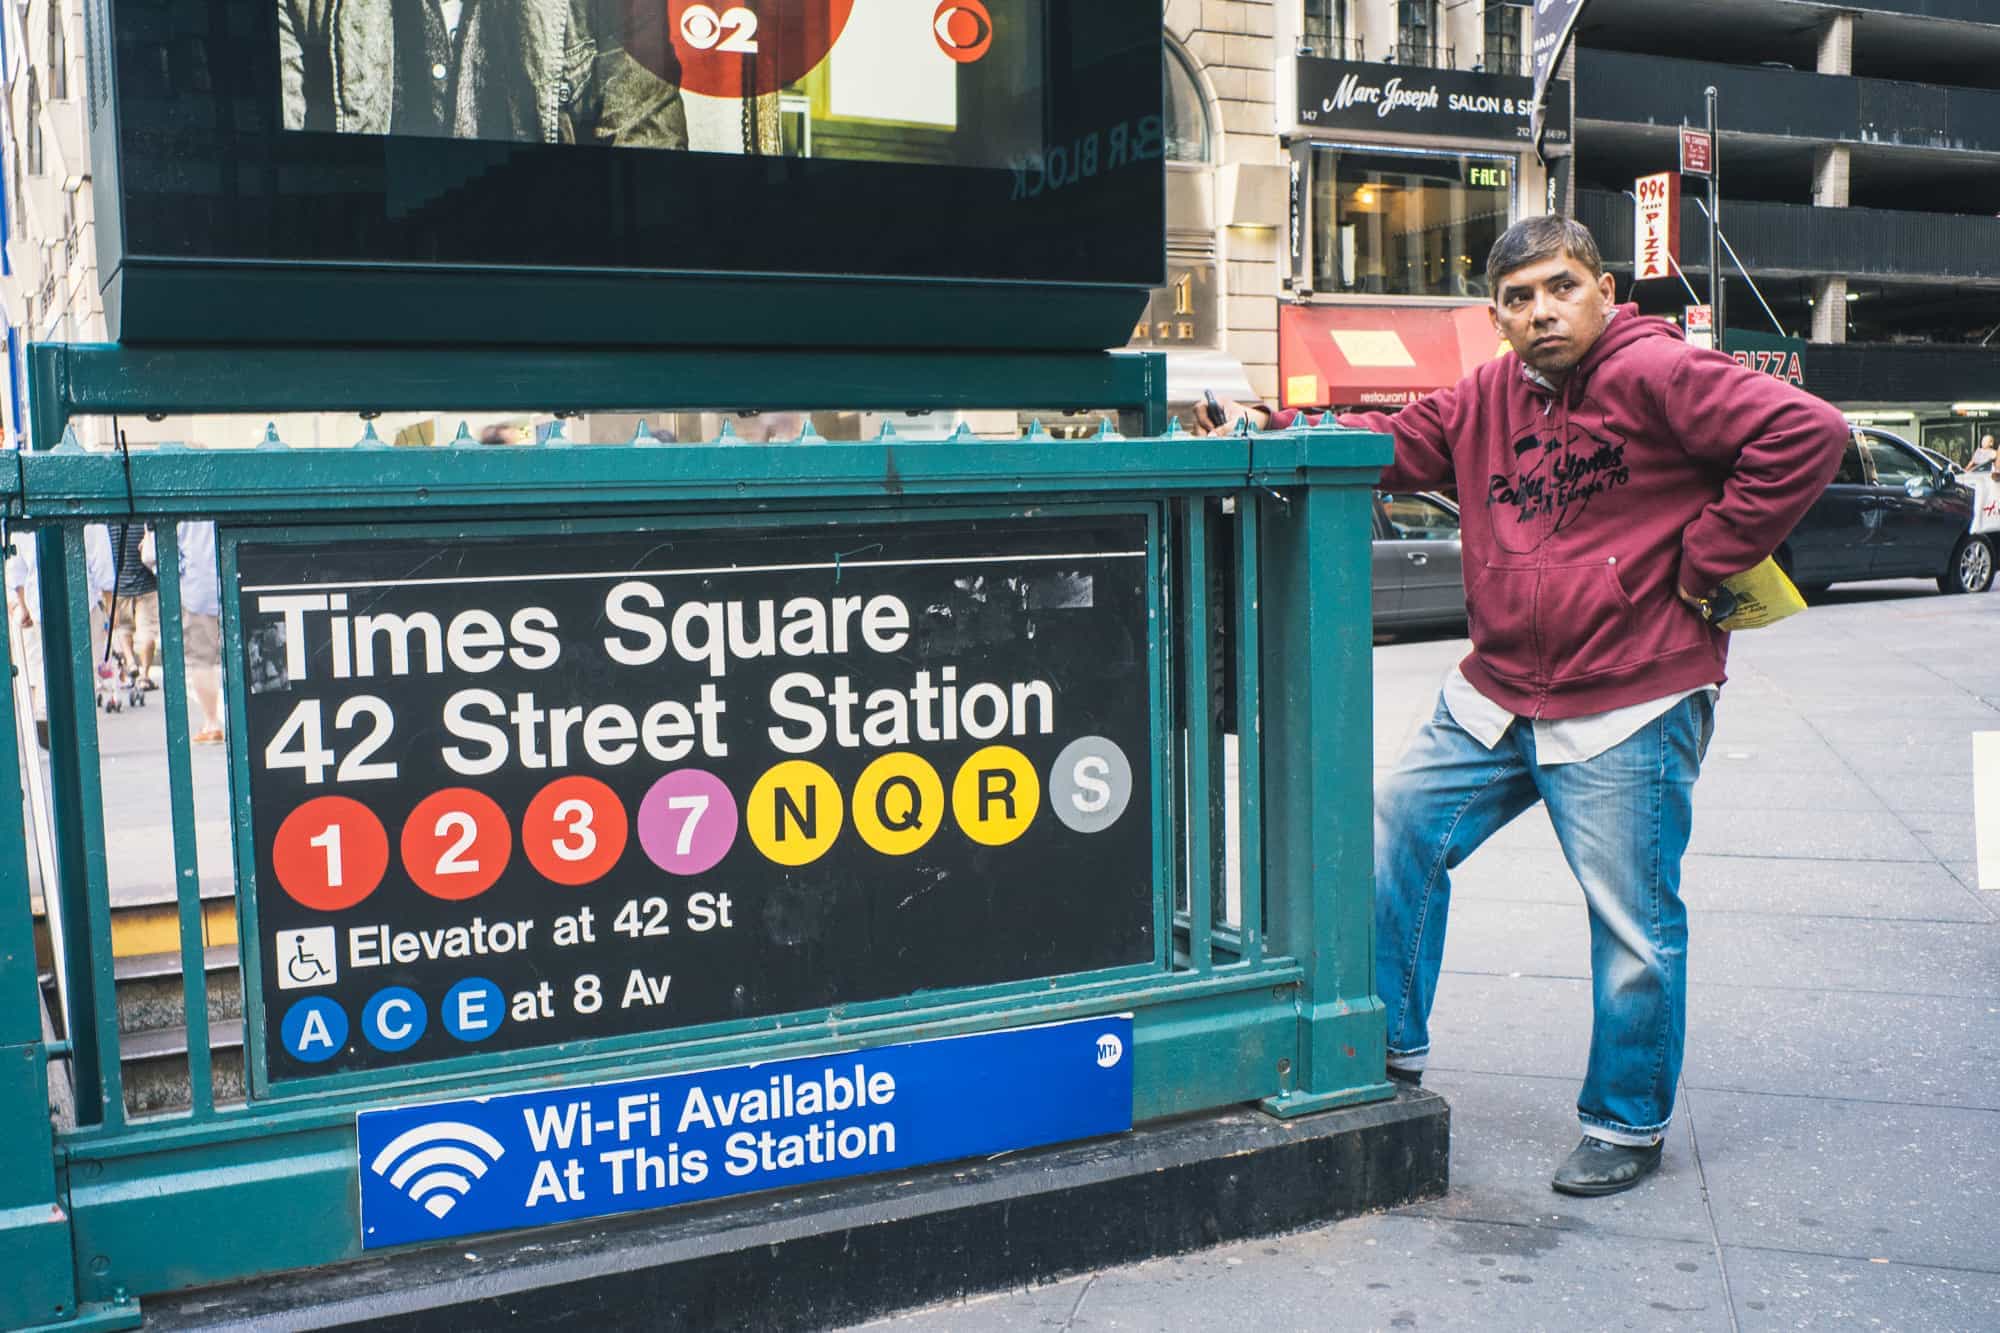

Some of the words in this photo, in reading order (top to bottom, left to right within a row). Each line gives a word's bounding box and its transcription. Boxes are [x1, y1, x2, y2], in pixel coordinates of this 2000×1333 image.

[1302, 110, 1318, 120] 147
[1322, 73, 1381, 112] Marc
[1377, 77, 1439, 117] Joseph
[1448, 94, 1500, 113] SALON
[1503, 98, 1514, 114] &
[1517, 99, 1538, 115] SP
[1643, 212, 1659, 277] PIZZA
[258, 593, 561, 680] Times
[604, 581, 910, 677] Square
[265, 695, 398, 784] 42
[442, 684, 728, 776] Street
[768, 666, 1054, 754] Station
[310, 824, 342, 887] 1
[434, 811, 480, 875] 2
[551, 799, 597, 861] 3
[668, 795, 710, 856] 7
[774, 785, 817, 841] N
[875, 775, 923, 831] Q
[977, 767, 1017, 822] R
[1071, 756, 1112, 813] S
[349, 917, 534, 968] Elevator
[553, 907, 595, 946] at
[613, 897, 670, 939] 42
[687, 892, 733, 931] St
[297, 1010, 335, 1052] A
[376, 999, 412, 1040] C
[457, 990, 488, 1031] E
[511, 981, 554, 1022] at
[573, 974, 603, 1014] 8
[621, 969, 671, 1010] Av
[1096, 1044, 1117, 1060] MTA
[523, 1092, 661, 1152] Wi-Fi
[677, 1064, 896, 1133] Available
[525, 1160, 585, 1207] At
[600, 1142, 708, 1195] This
[724, 1119, 896, 1177] Station
